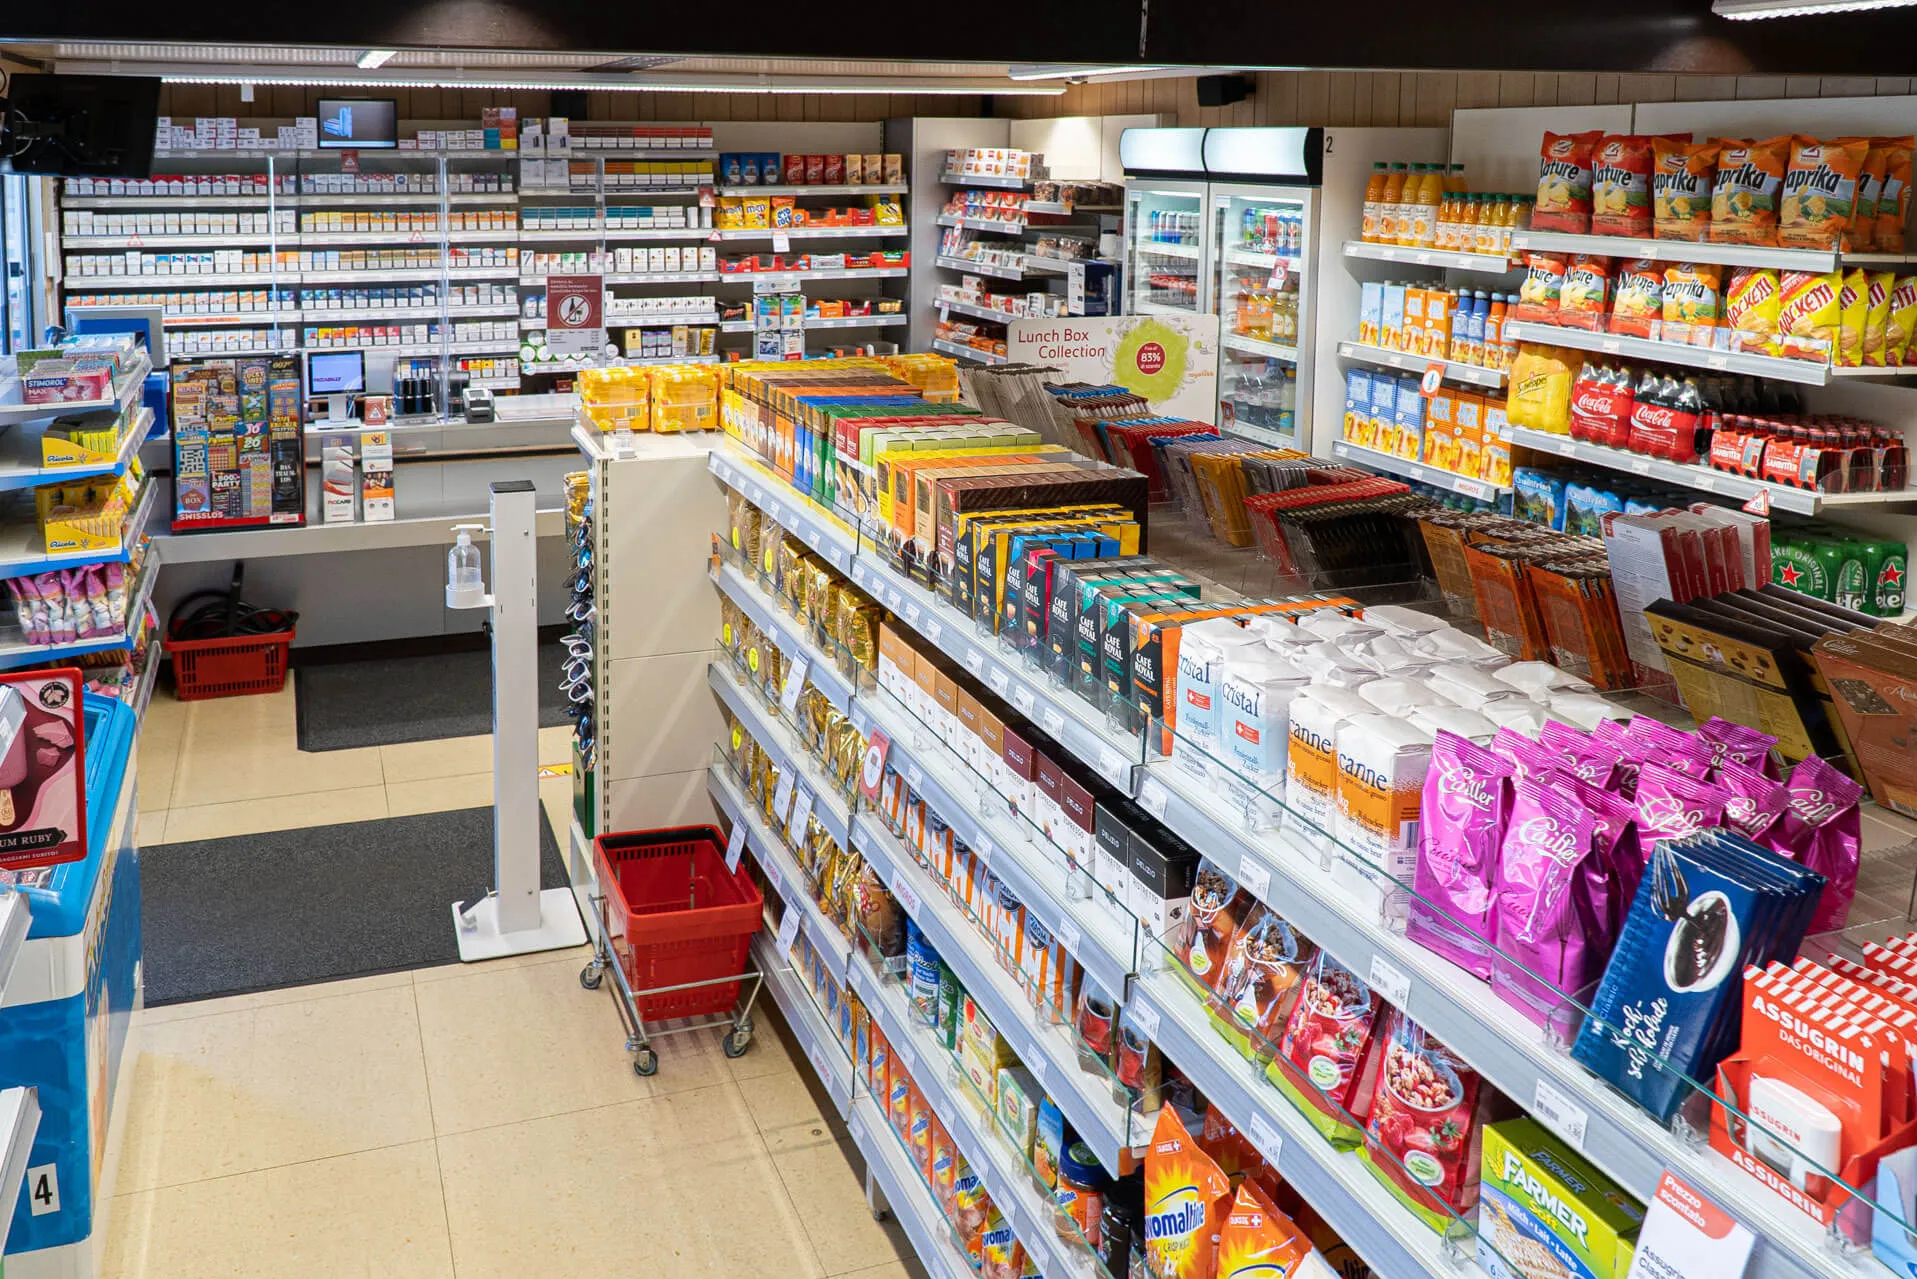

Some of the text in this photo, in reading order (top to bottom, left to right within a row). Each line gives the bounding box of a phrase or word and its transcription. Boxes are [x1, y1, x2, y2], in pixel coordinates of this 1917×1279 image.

[1326, 136, 1333, 153] 2
[1655, 169, 1698, 194] aprika
[1715, 163, 1767, 192] aprika
[1786, 164, 1841, 194] aprika
[1529, 265, 1553, 284] ture
[1728, 276, 1774, 329] NACKETTI
[1779, 283, 1834, 336] NACKETTI
[1018, 328, 1089, 343] Lunch Box
[1038, 345, 1105, 359] Collection
[1141, 353, 1160, 362] 83%
[28, 379, 64, 388] STIMOROL
[1635, 406, 1673, 427] Coca-Cola
[212, 481, 240, 489] PARTY
[179, 510, 224, 520] SWISSLOS
[1794, 551, 1823, 589] ORIGINAL
[1078, 624, 1096, 642] ROYAL
[1104, 643, 1123, 661] ROYAL
[1135, 662, 1155, 681] ROYAL
[1222, 682, 1260, 718] cristal
[1289, 719, 1331, 755] canne
[1338, 753, 1388, 792] canne
[1438, 767, 1494, 806] Cailler
[21, 833, 52, 845] RUBY
[1101, 829, 1119, 848] DELIZIO
[1519, 816, 1578, 862] Cailler
[1136, 858, 1156, 878] DELIZIO
[1752, 995, 1865, 1074] ASSUGRIN
[1779, 1027, 1863, 1089] DAS ORIGINAL
[1530, 1151, 1586, 1193] FARMER
[1732, 1149, 1824, 1221] ASSUGRIN
[34, 1174, 53, 1205] 4
[1503, 1150, 1590, 1252] FARMER
[1664, 1175, 1702, 1208] Prezzo
[1145, 1200, 1205, 1241] vomaltine
[1660, 1188, 1706, 1227] scontato
[1507, 1201, 1579, 1271] Milch Lait Latte
